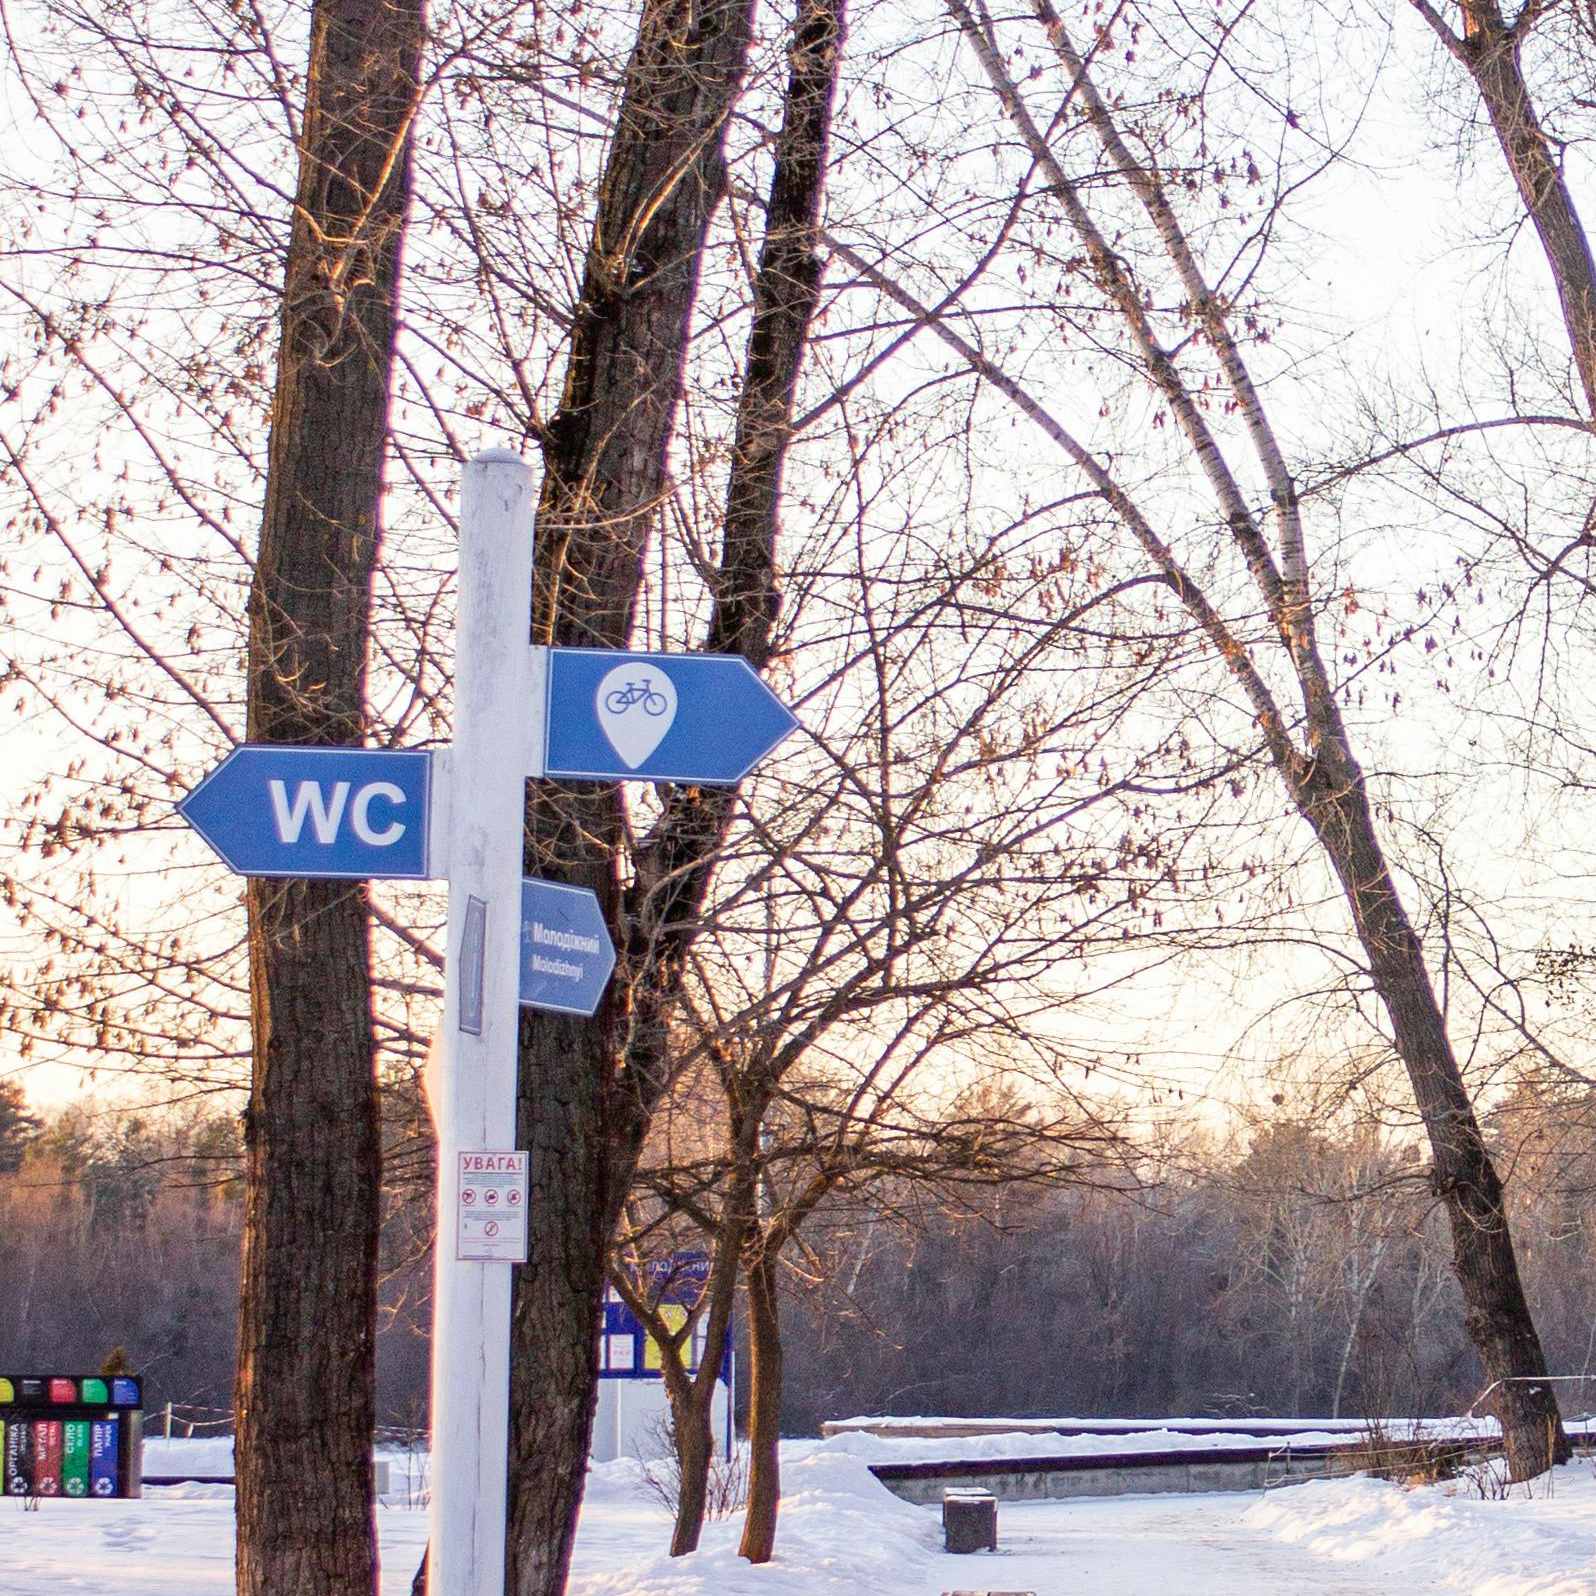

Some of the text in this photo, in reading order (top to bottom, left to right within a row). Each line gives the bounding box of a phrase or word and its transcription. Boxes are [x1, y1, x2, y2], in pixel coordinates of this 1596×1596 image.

[270, 780, 407, 846] WC
[532, 922, 600, 954] Молодіжний
[463, 1156, 522, 1170] УВАГА!
[9, 1423, 19, 1476] ОРГАНІКА
[38, 1423, 48, 1460] МЕТАЛ
[94, 1424, 103, 1457] ПАПІР
